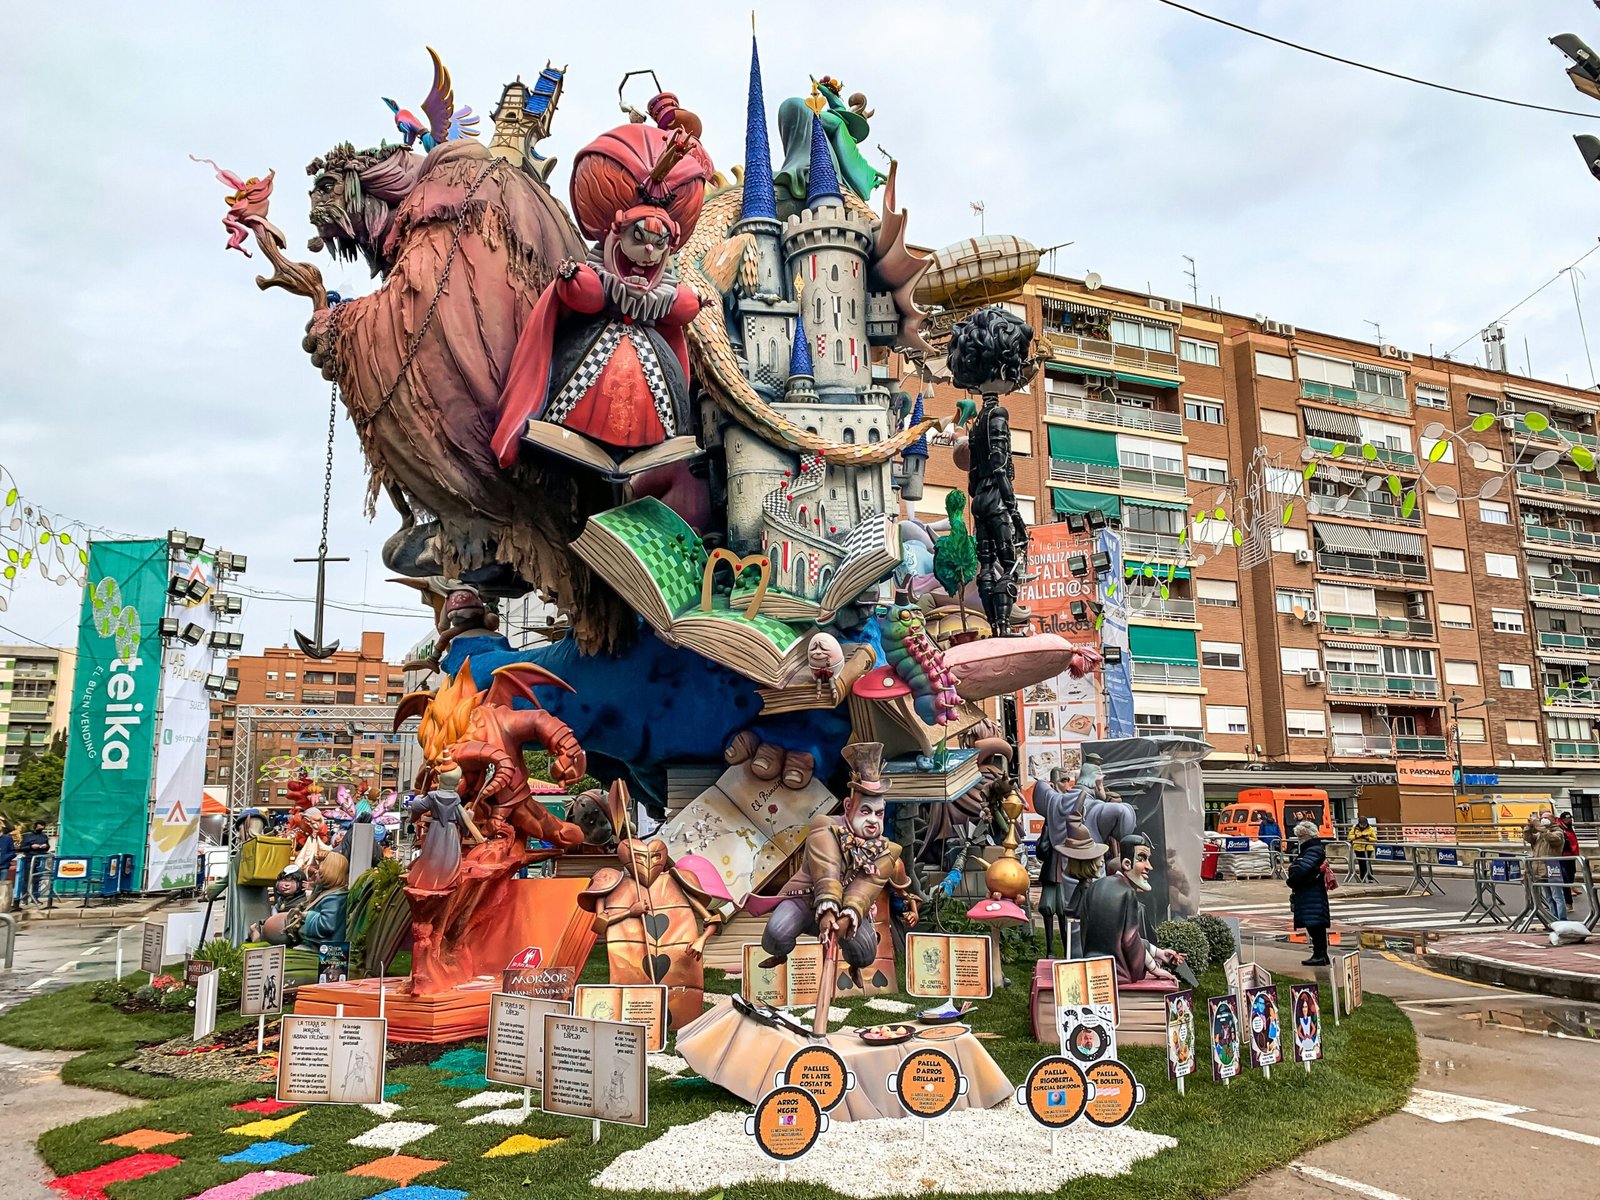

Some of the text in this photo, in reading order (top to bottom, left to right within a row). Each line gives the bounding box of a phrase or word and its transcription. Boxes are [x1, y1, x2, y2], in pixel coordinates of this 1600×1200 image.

[1021, 580, 1091, 601] FALLER@S
[168, 653, 185, 667] LAS
[172, 666, 209, 683] PALMERA
[81, 665, 104, 759] EL BUEN VENDING
[101, 658, 143, 769] teika
[1410, 768, 1451, 776] PAPONAZO
[511, 969, 568, 985] MORDOR
[912, 1075, 946, 1083] BRILLANTE
[1040, 1076, 1074, 1084] RIGOBERTA
[1100, 1077, 1124, 1085] BOLETUS
